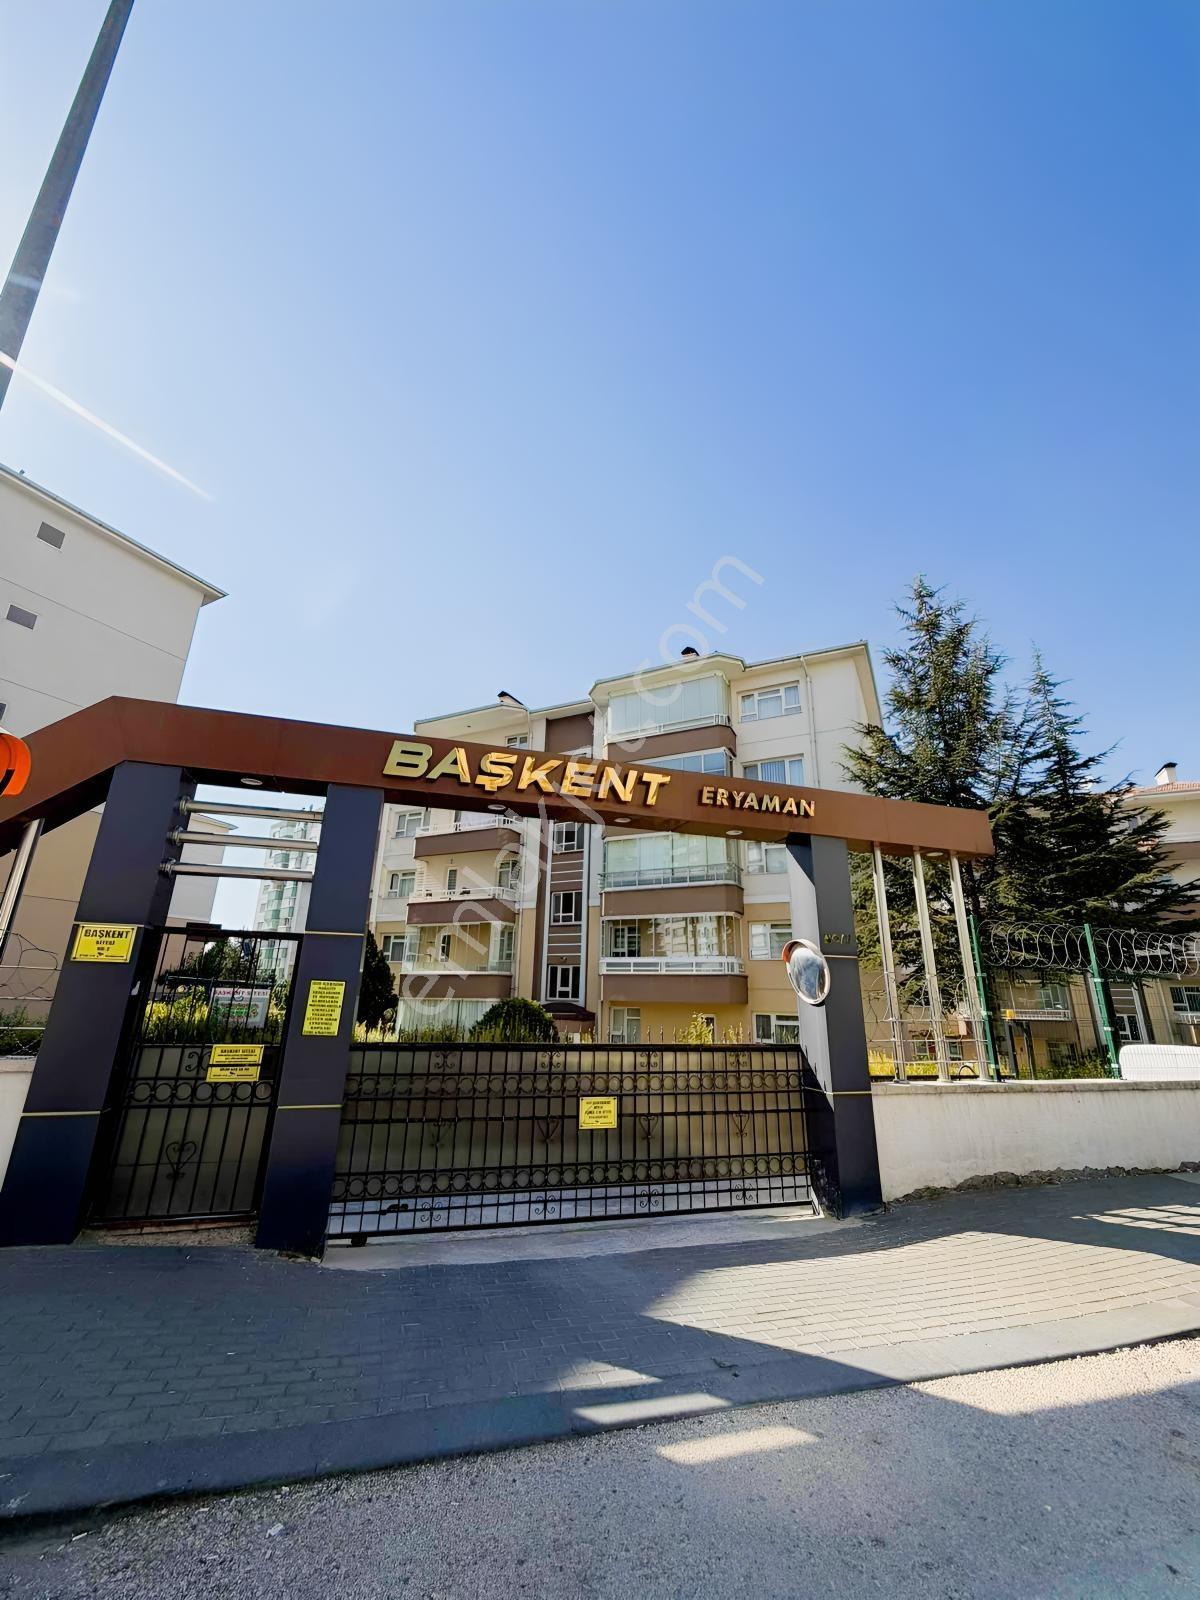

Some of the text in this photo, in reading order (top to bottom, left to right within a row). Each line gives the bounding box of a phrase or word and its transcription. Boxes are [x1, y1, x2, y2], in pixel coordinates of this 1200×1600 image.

[382, 740, 816, 817] BAŞKENT ERYAMAN
[84, 929, 131, 939] BAŞKENT
